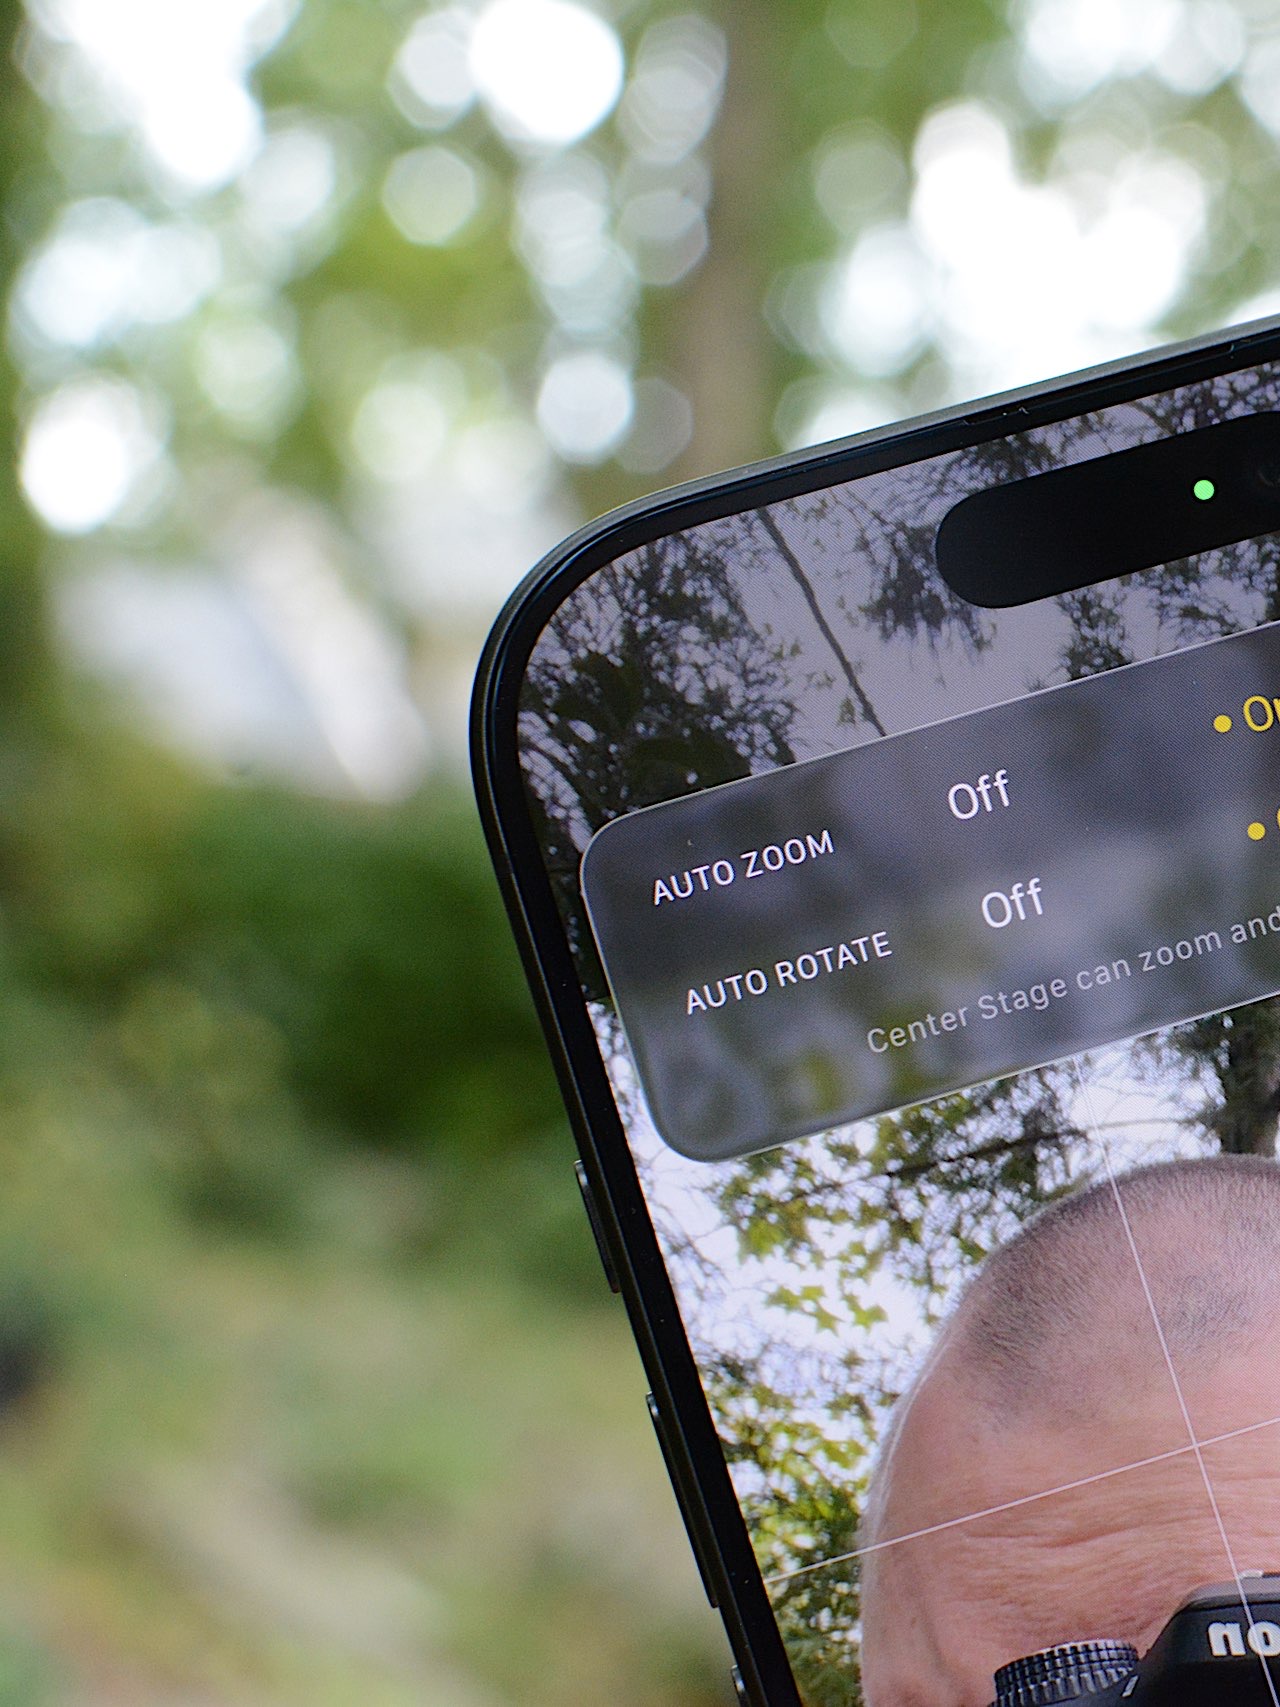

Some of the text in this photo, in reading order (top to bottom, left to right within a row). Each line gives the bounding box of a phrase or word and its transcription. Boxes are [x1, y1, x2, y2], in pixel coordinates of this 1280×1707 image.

[947, 769, 1011, 820] Off
[652, 830, 834, 905] AUTO ZOOM
[981, 877, 1044, 929] Off
[686, 931, 893, 1015] AUTO ROTATE
[867, 1005, 968, 1054] Center
[977, 974, 1069, 1021] Stage
[1076, 958, 1131, 992] can
[1138, 930, 1223, 971] zoom
